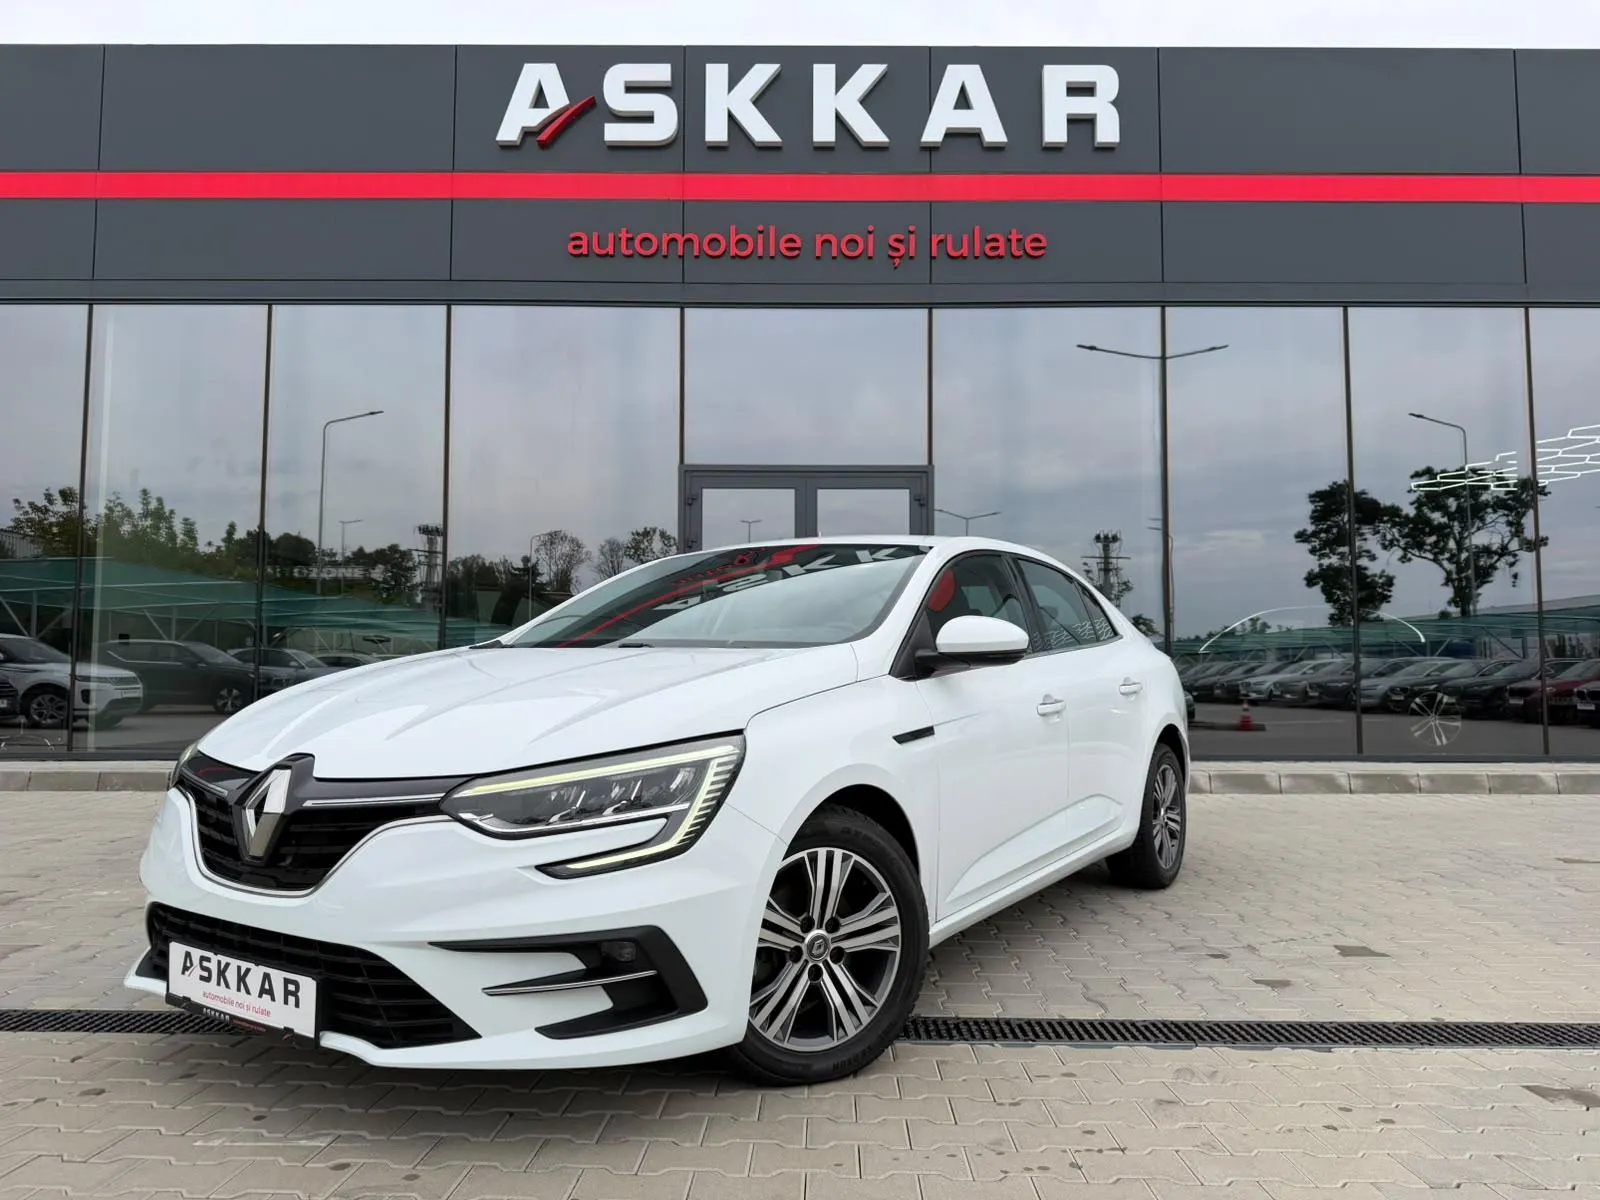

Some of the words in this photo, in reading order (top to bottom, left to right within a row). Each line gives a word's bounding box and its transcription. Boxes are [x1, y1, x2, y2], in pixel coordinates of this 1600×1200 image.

[495, 62, 1121, 149] ASKKAR
[567, 224, 802, 258] automobile
[815, 224, 875, 259] noi
[887, 224, 917, 269] și
[930, 224, 1049, 258] rulate
[180, 950, 301, 1009] ASKKAR
[202, 990, 235, 1007] automobile
[235, 1001, 245, 1011] noi
[251, 1005, 271, 1018] rulate
